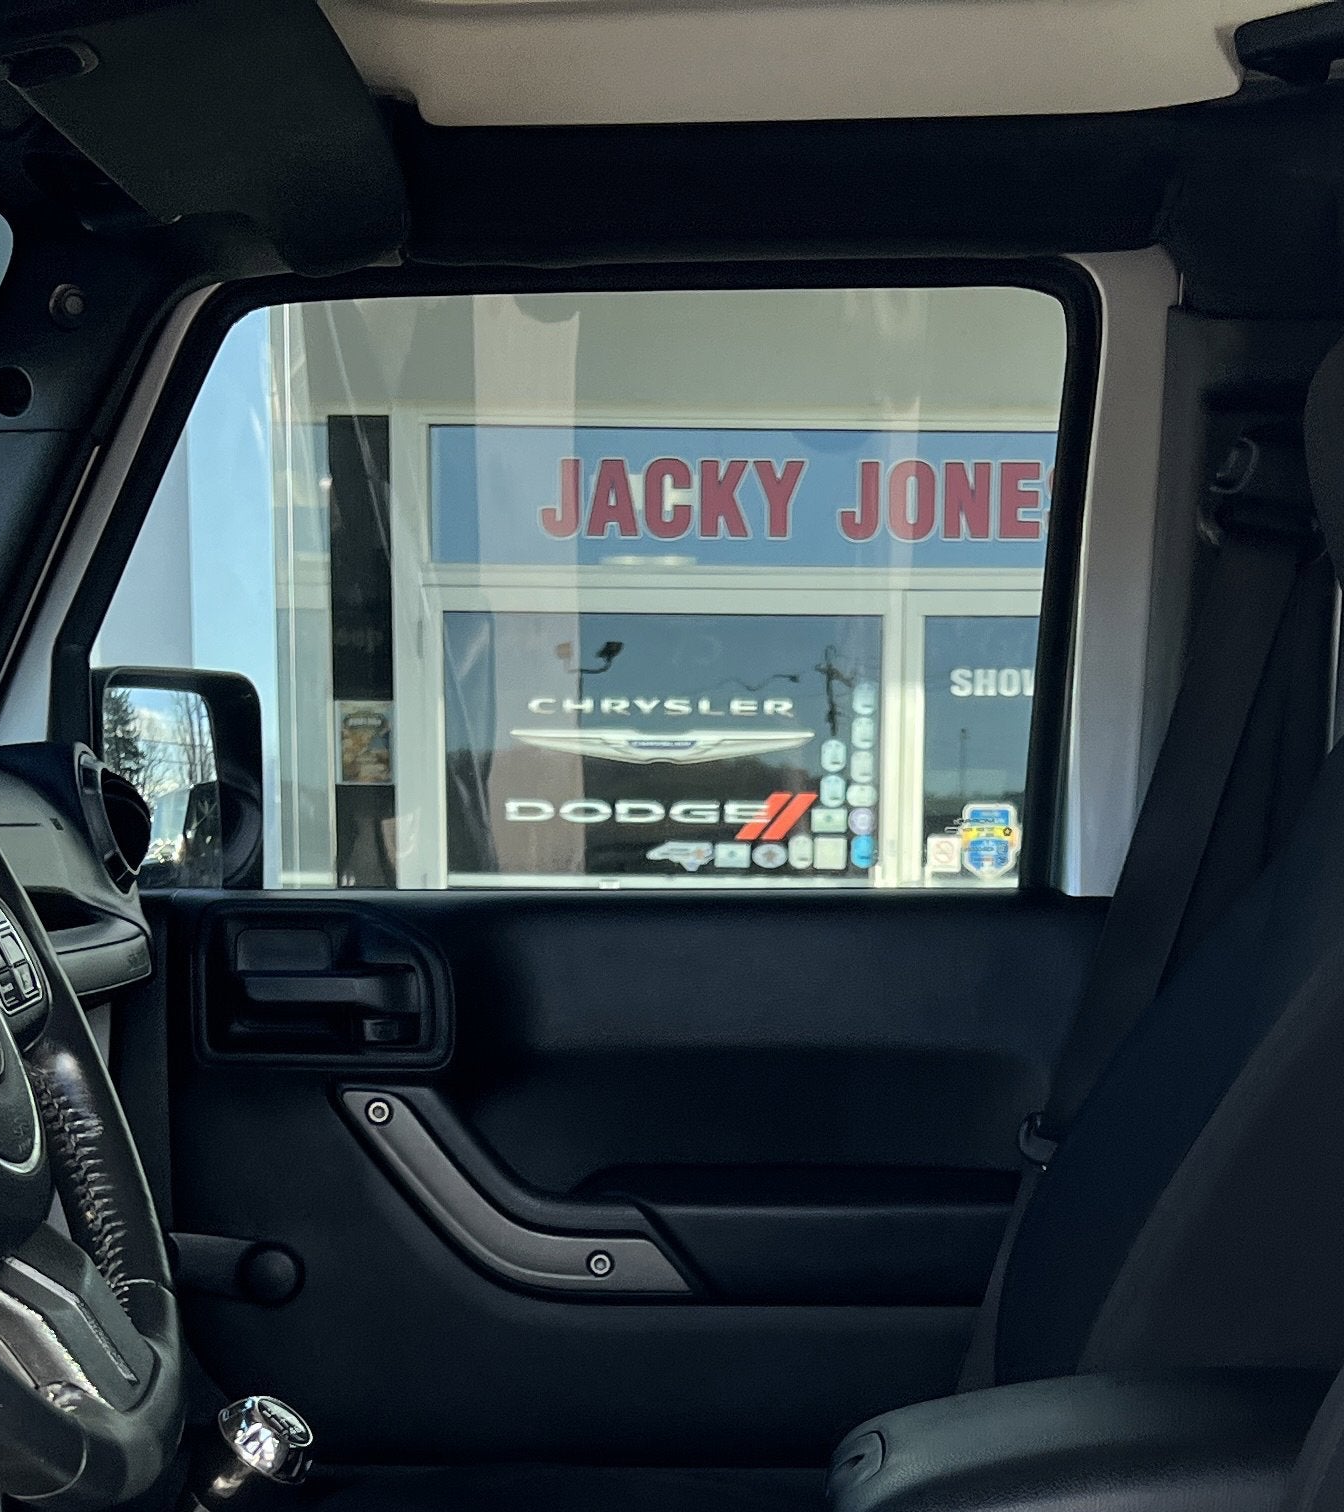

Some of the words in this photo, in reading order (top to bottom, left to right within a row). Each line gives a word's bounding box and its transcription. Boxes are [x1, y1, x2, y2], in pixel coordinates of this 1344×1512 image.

[538, 457, 806, 541] JACKY
[837, 459, 1055, 543] JONE
[527, 698, 794, 717] CHRYSLER
[505, 800, 771, 823] DODGE
